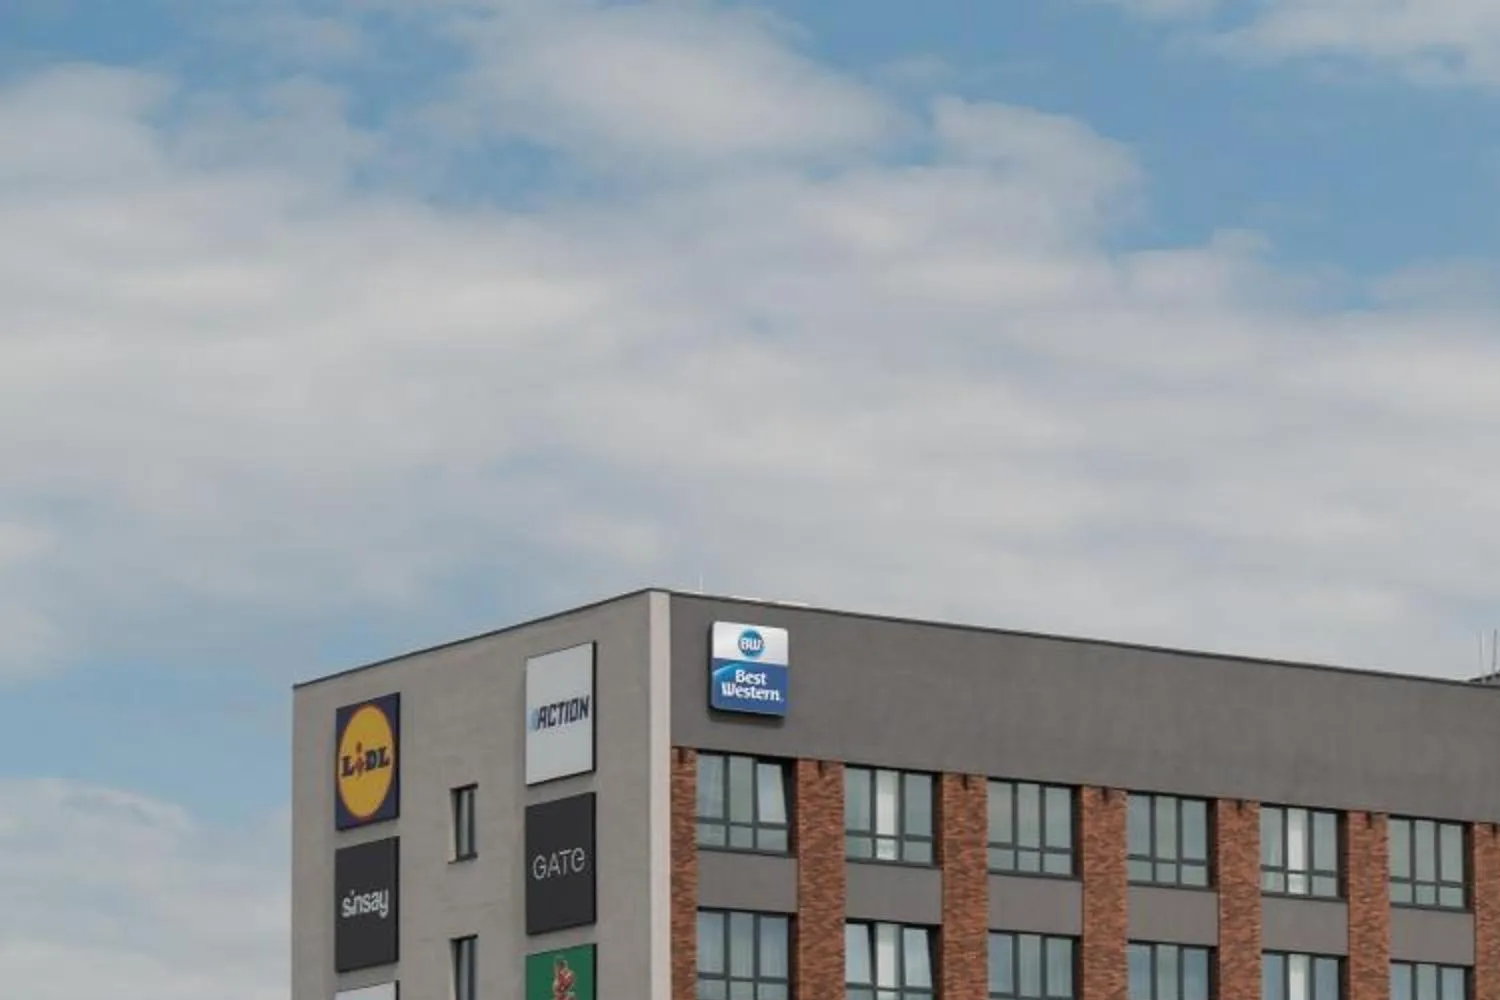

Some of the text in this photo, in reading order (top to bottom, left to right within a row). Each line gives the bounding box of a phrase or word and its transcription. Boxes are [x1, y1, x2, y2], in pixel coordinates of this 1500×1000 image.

[735, 669, 767, 686] Best
[721, 681, 781, 702] Western
[537, 695, 590, 729] ACTION
[341, 889, 389, 919] sinsay
